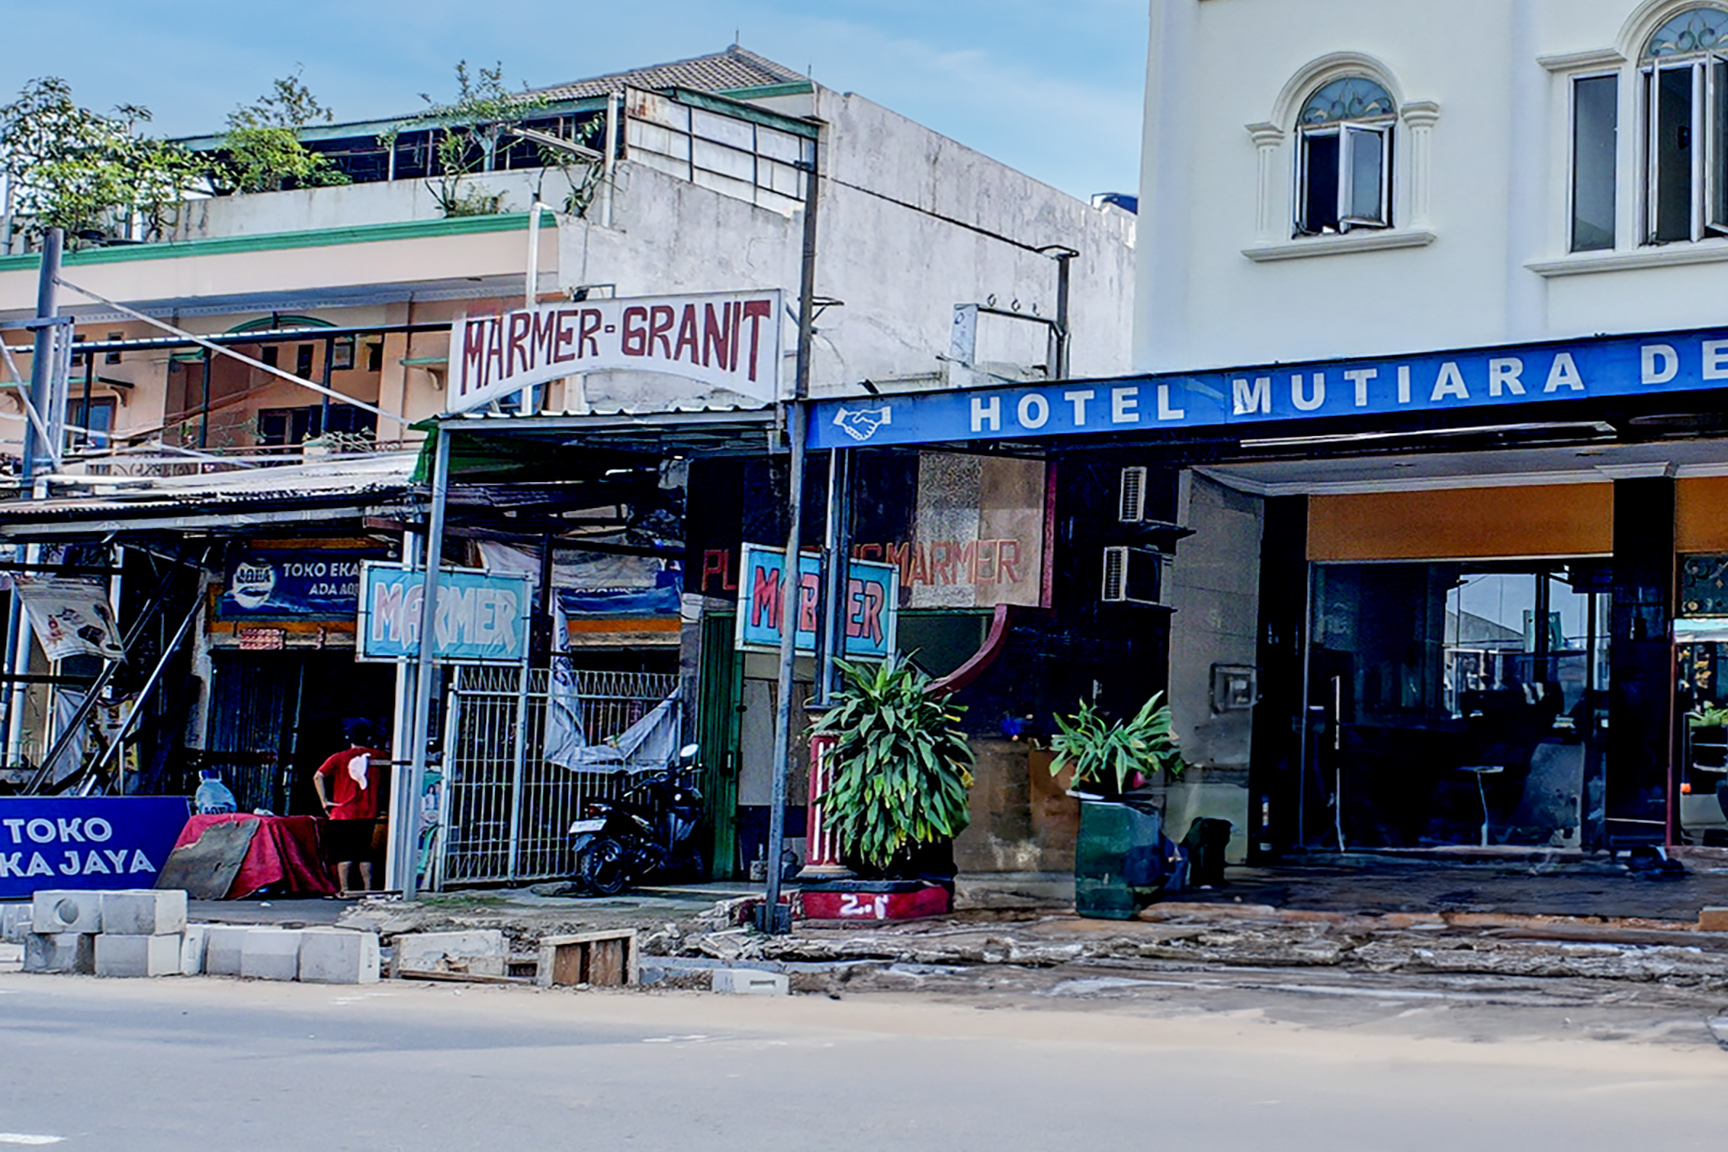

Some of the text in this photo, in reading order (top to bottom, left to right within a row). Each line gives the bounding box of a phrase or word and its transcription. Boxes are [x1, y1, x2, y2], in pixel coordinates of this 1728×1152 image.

[970, 385, 1186, 431] HOTEL
[1232, 352, 1584, 415] MUTIARA
[282, 562, 327, 578] TOKO
[885, 539, 1021, 587] MARMER
[308, 582, 338, 596] ADA
[371, 581, 519, 654] MARMER
[3, 816, 113, 844] TOKO
[59, 848, 157, 877] JAYA
